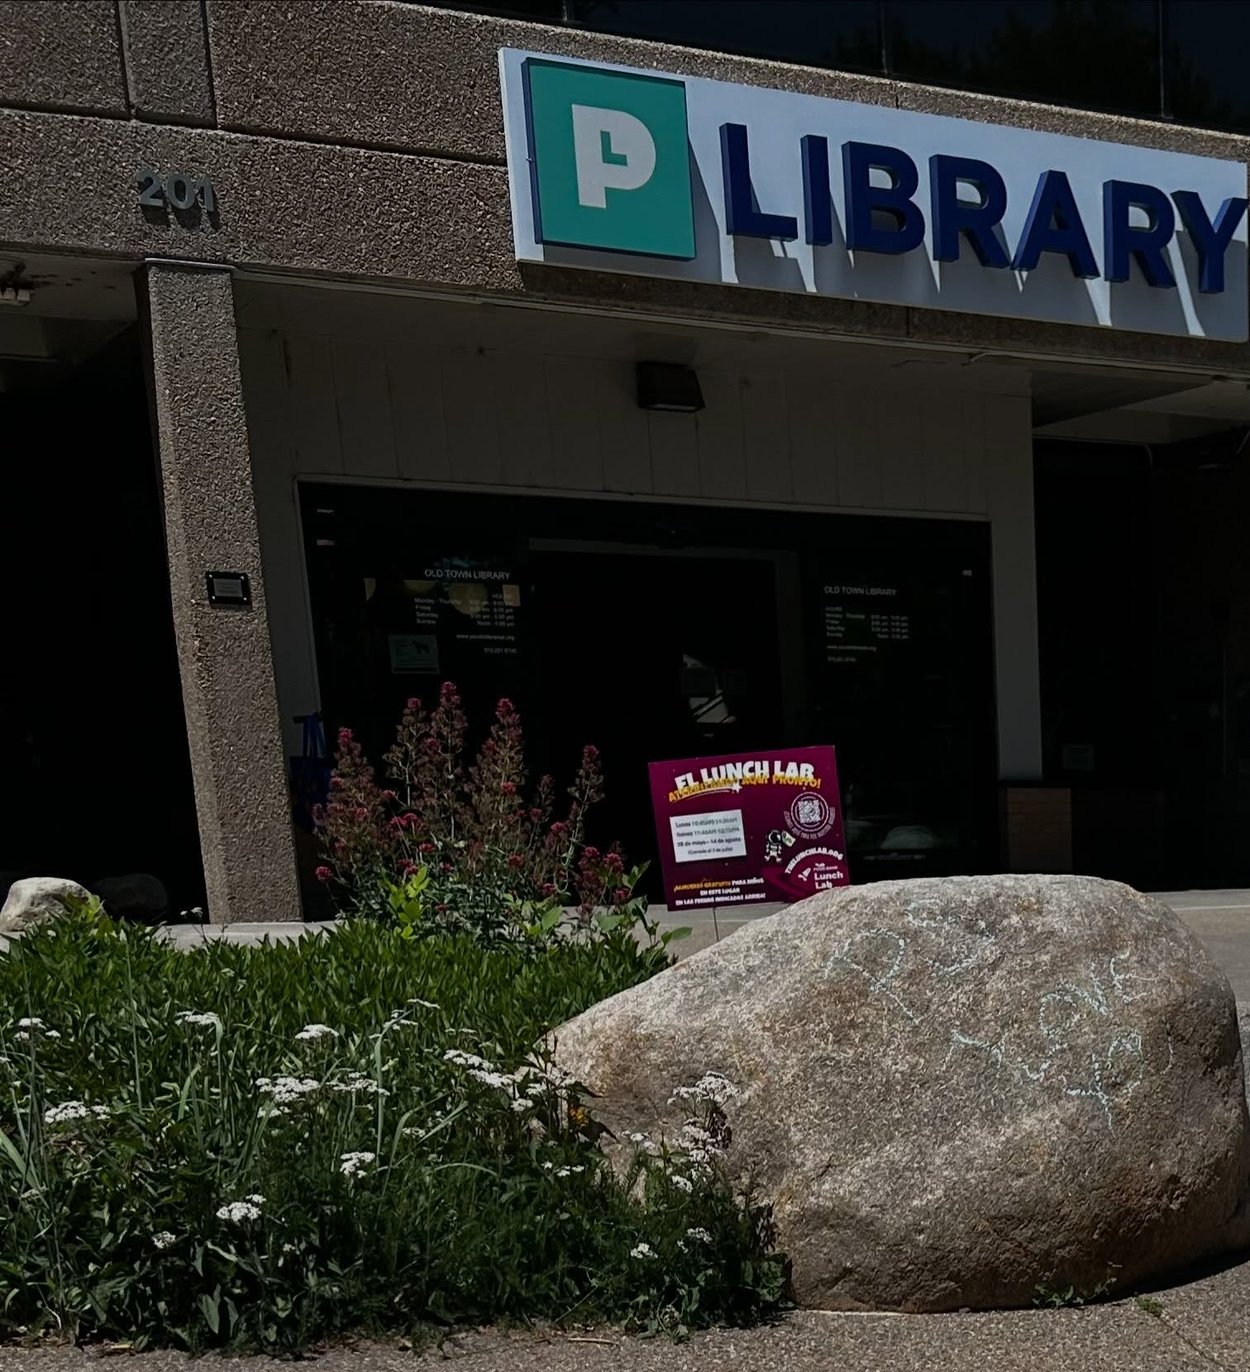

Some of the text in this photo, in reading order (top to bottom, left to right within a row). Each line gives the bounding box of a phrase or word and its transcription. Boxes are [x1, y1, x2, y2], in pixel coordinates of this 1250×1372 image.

[137, 167, 215, 213] 201
[719, 122, 1250, 294] LIBRARY
[424, 568, 511, 580] OLD TOWN LIBRARY
[824, 586, 896, 596] OLD TOWN LIBRARY
[675, 760, 815, 791] EL LUNCH LAB
[814, 871, 844, 880] Lunch
[815, 880, 833, 889] Lab
